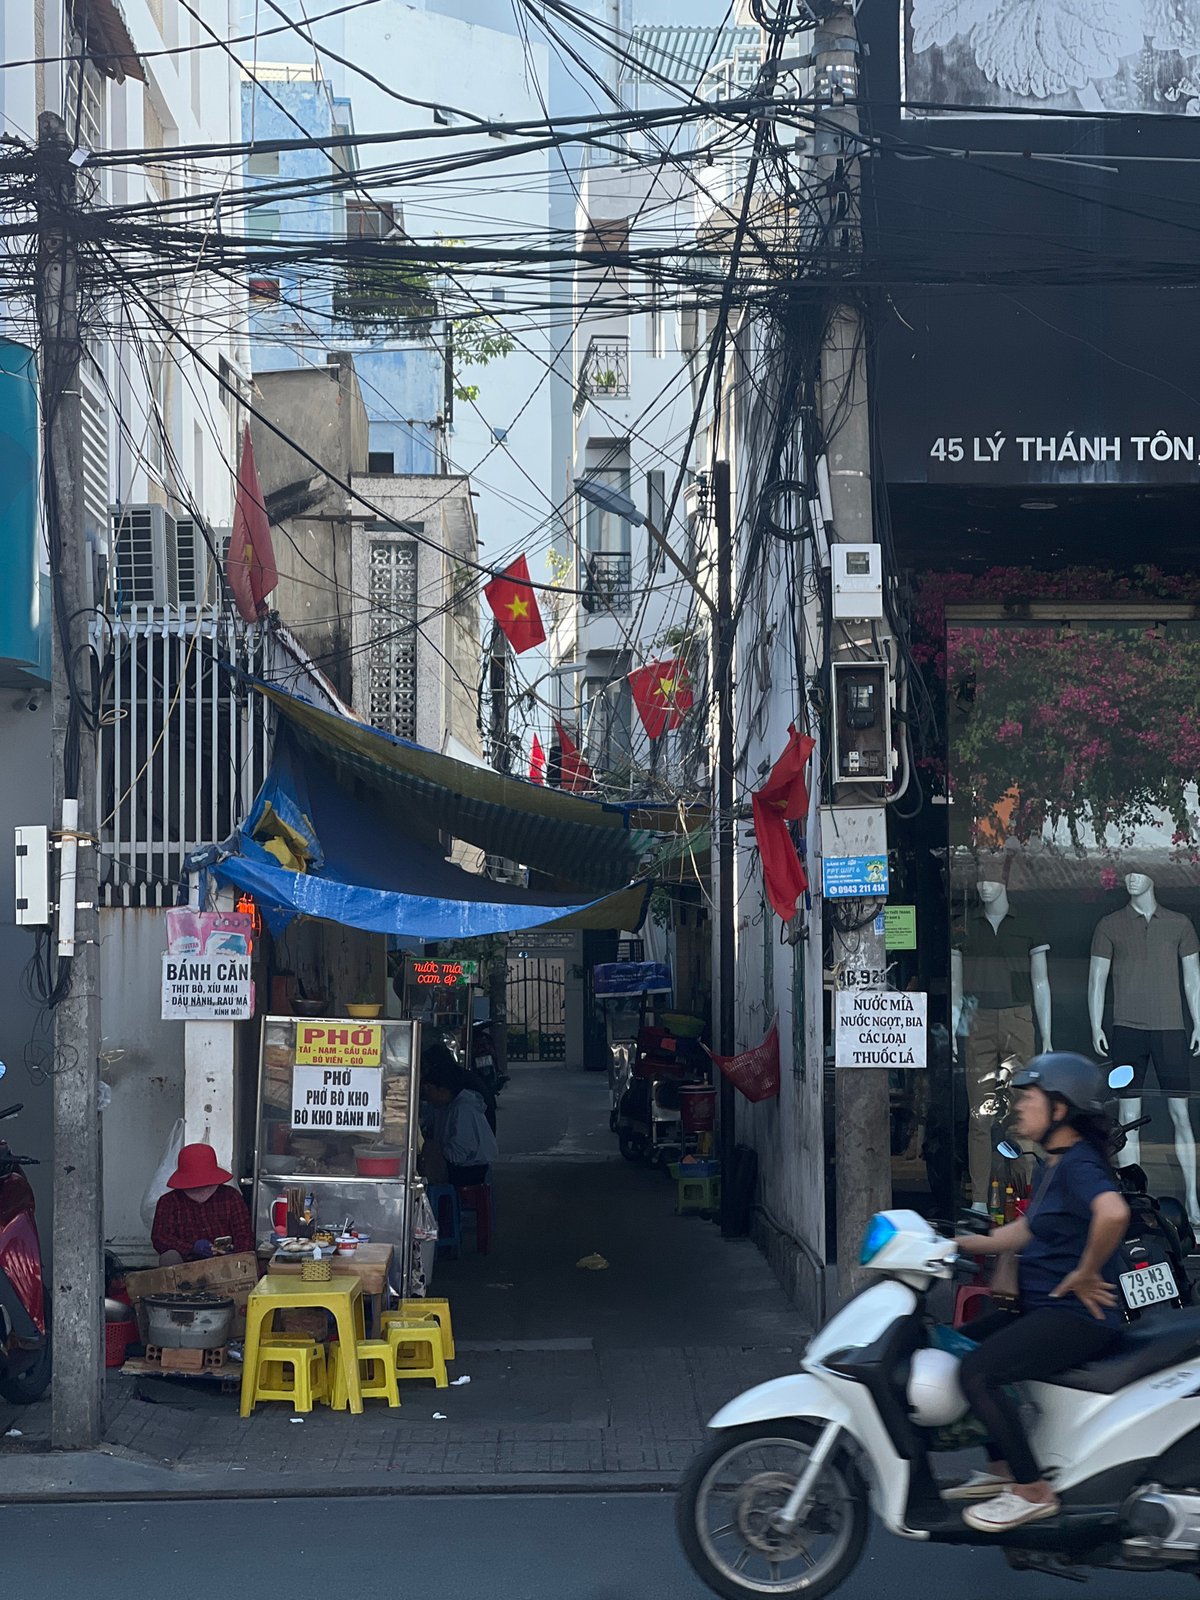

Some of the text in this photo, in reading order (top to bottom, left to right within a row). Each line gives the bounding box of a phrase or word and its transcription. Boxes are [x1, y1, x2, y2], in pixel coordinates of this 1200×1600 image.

[930, 437, 964, 462] 45
[973, 430, 1006, 462] LÝ
[1016, 430, 1121, 462] THÁNH
[838, 884, 886, 894] 0943 211 414
[166, 958, 248, 980] BÁNH CĂN
[172, 984, 190, 995] THỊT
[192, 982, 206, 994] BÒ,
[207, 982, 220, 994] XÍU
[224, 984, 238, 996] MẠI
[417, 974, 457, 986] cam ép
[217, 996, 234, 1006] RAU
[840, 1014, 923, 1030] NƯỚC NGỌT, BIA
[304, 1024, 374, 1046] PHỞ
[858, 1029, 906, 1047] CÁC LOẠI
[853, 1046, 914, 1064] THUỐC LÁ
[323, 1067, 352, 1086] PHỞ
[306, 1086, 369, 1107] PHỞ BÒ KHO
[294, 1107, 380, 1127] BÒ KHO BÁNH MÌ
[1128, 1267, 1164, 1290] 79-N3
[1129, 1281, 1174, 1306] 136.69
